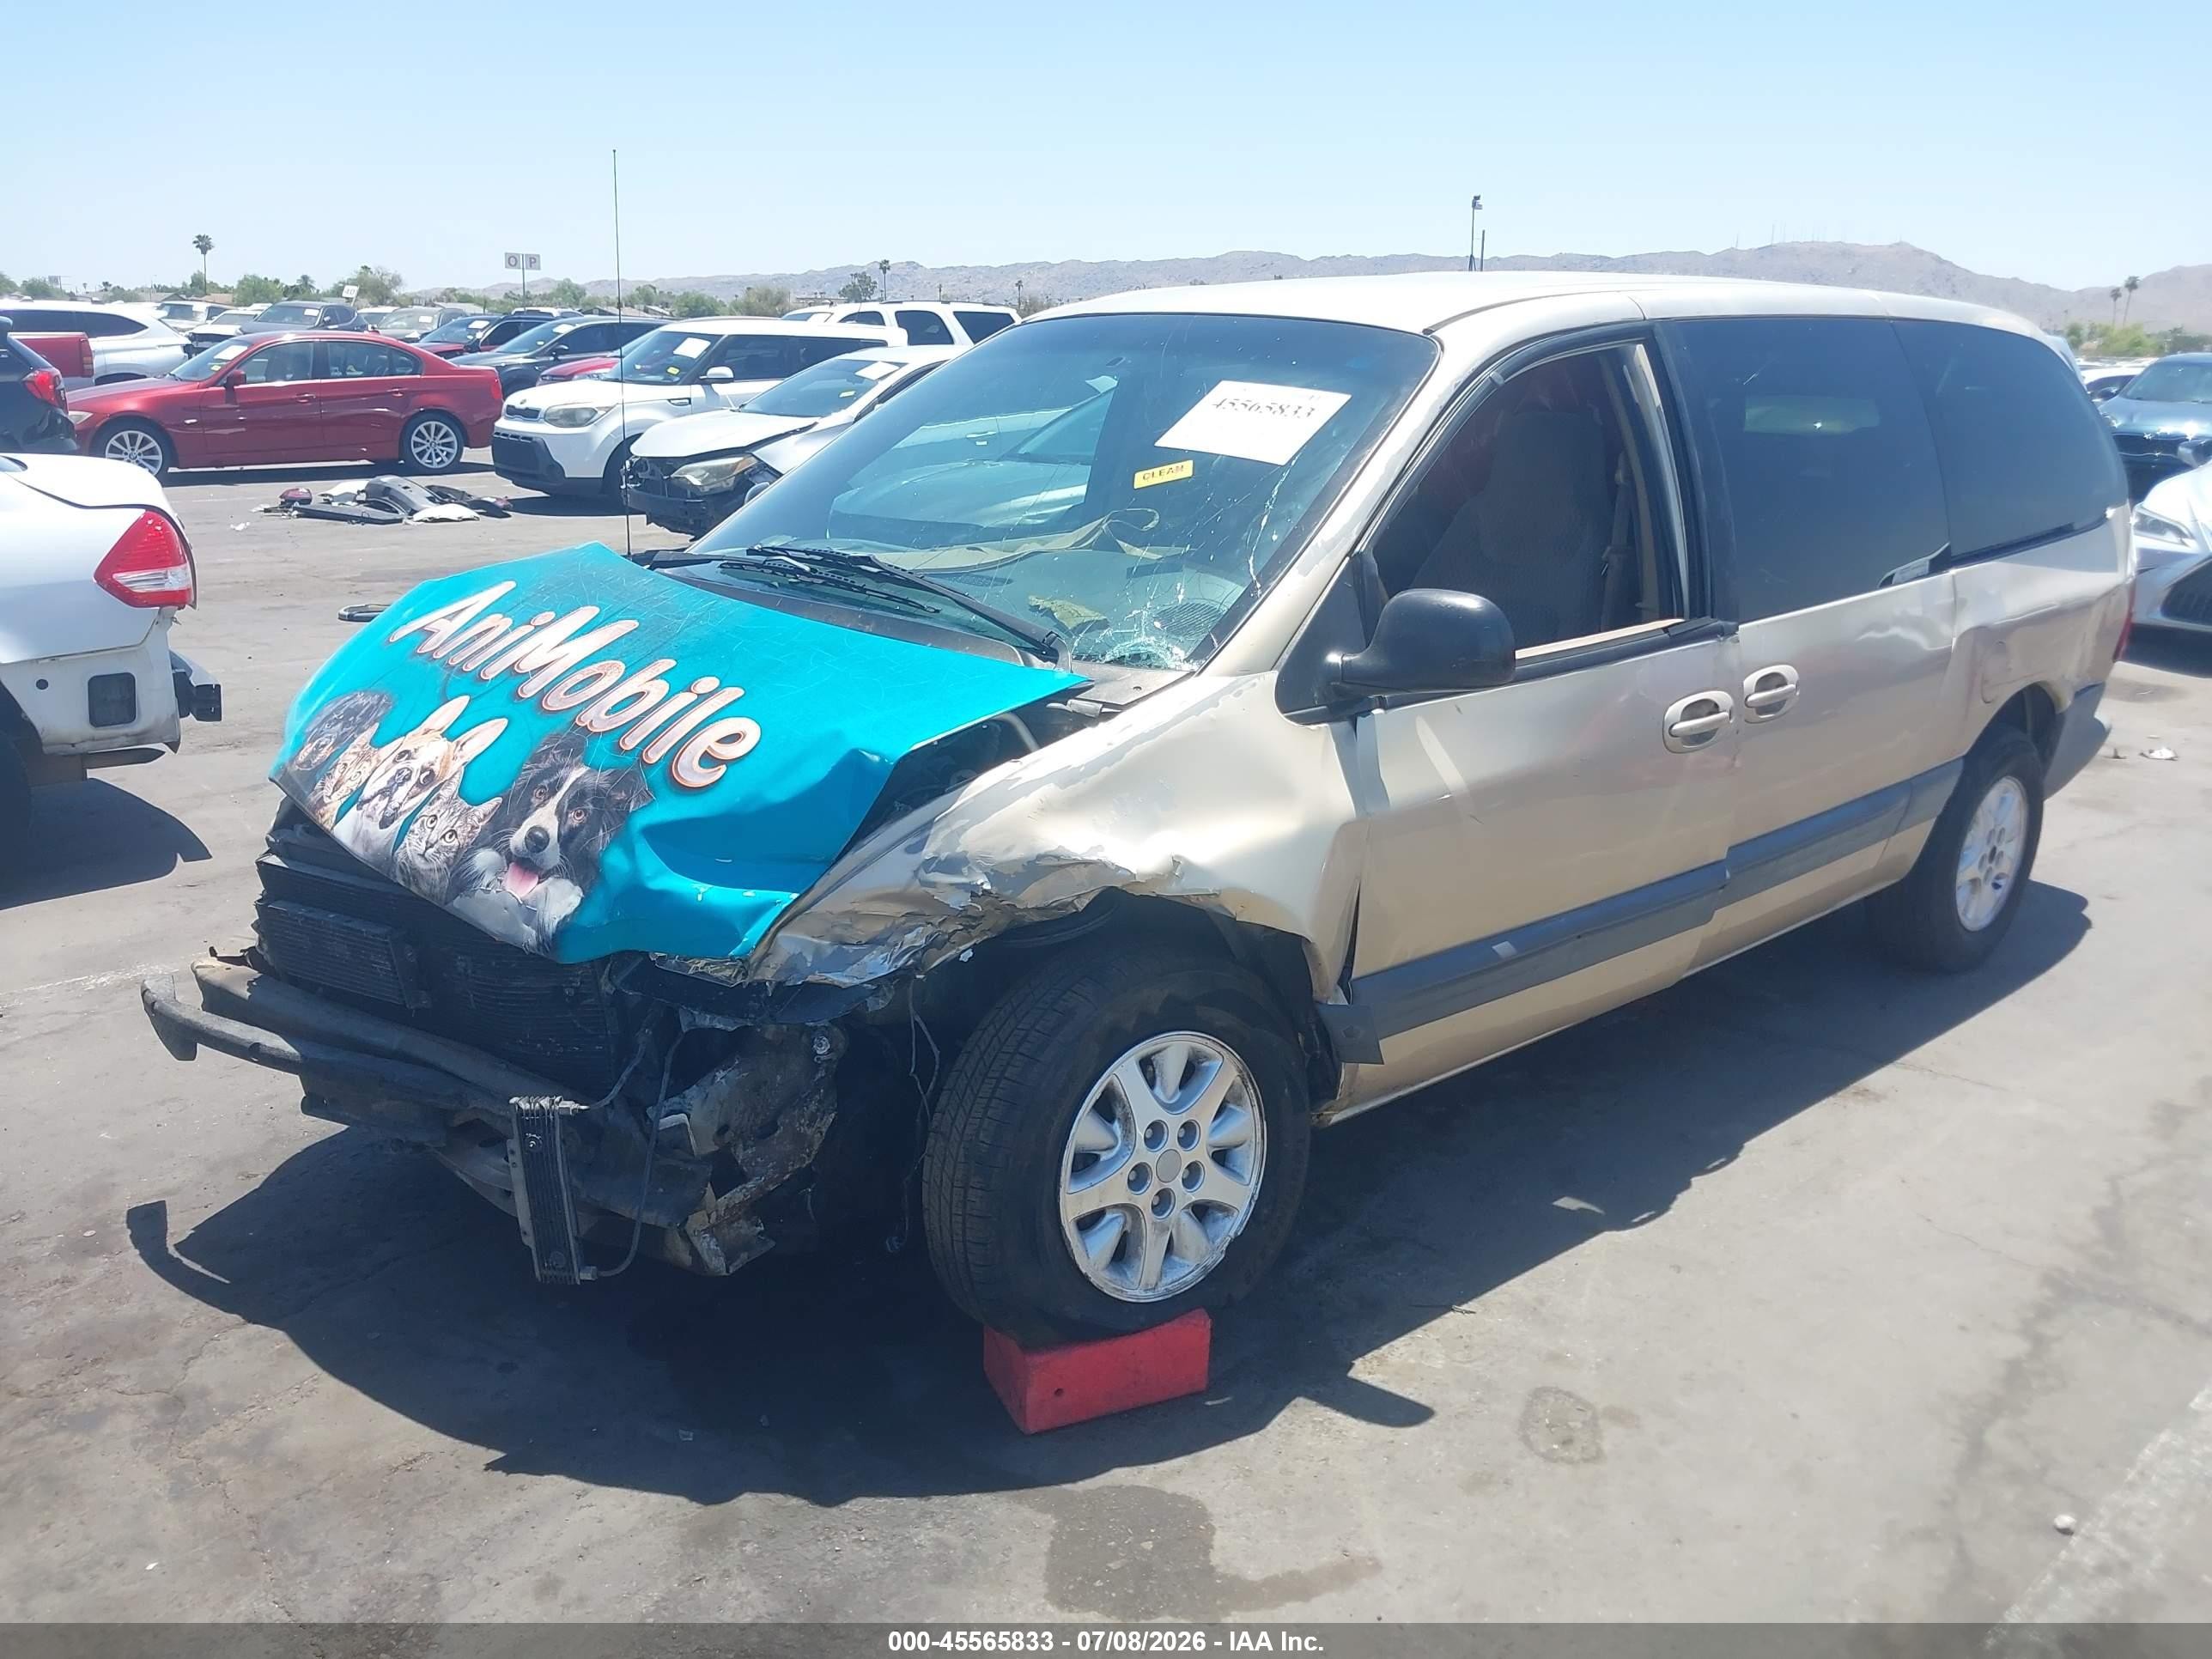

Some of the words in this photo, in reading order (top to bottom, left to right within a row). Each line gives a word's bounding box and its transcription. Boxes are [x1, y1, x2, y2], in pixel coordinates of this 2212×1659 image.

[529, 256, 537, 268] P
[1212, 398, 1316, 418] 45565833
[389, 580, 762, 788] AniMobile
